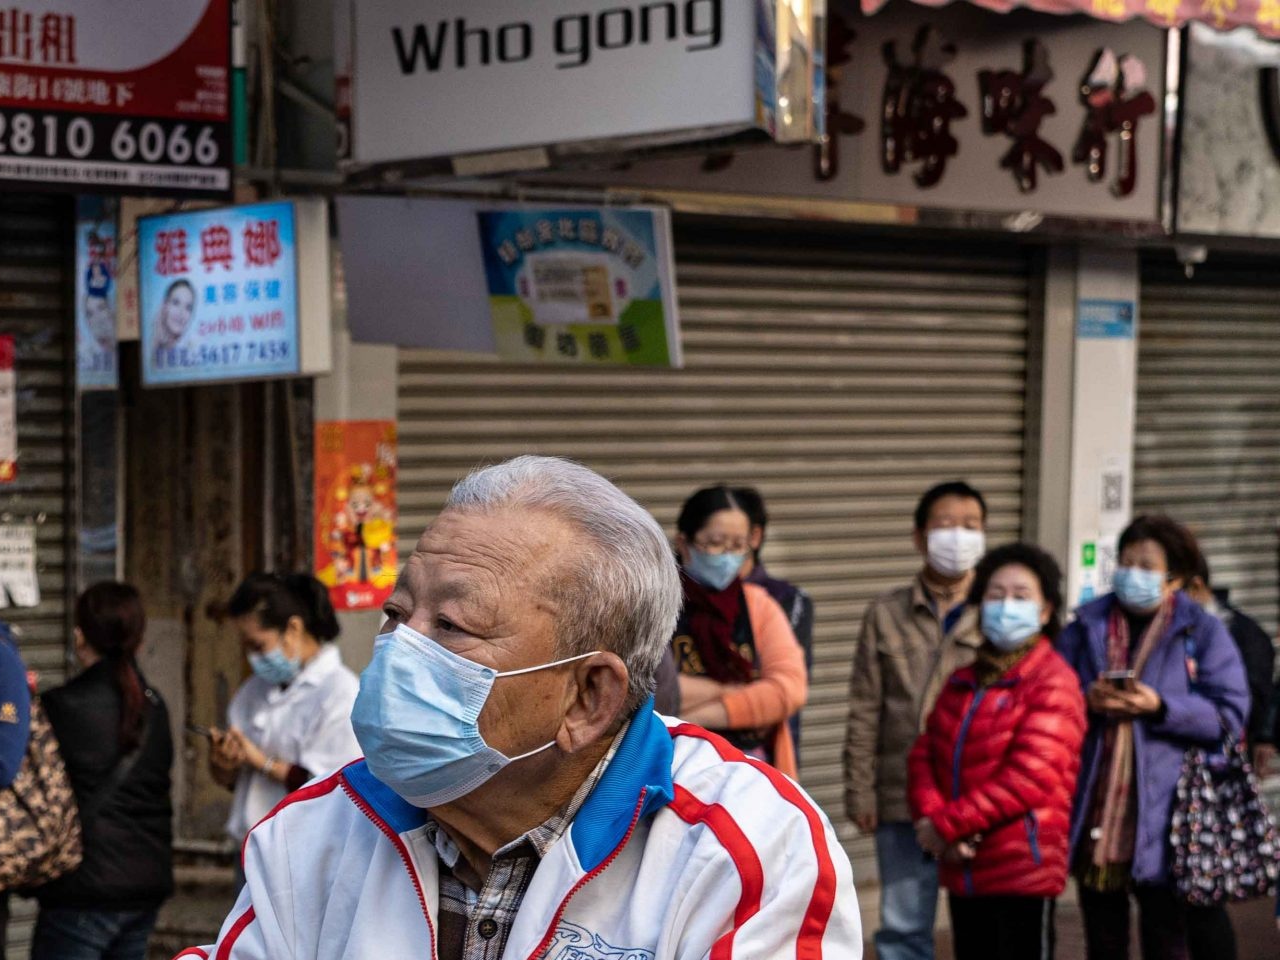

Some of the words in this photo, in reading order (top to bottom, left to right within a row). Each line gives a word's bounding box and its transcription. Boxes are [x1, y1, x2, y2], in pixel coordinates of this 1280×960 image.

[390, 17, 533, 75] Who
[554, 0, 723, 70] gong
[111, 122, 219, 165] 6066
[154, 220, 282, 276] 雅典娜
